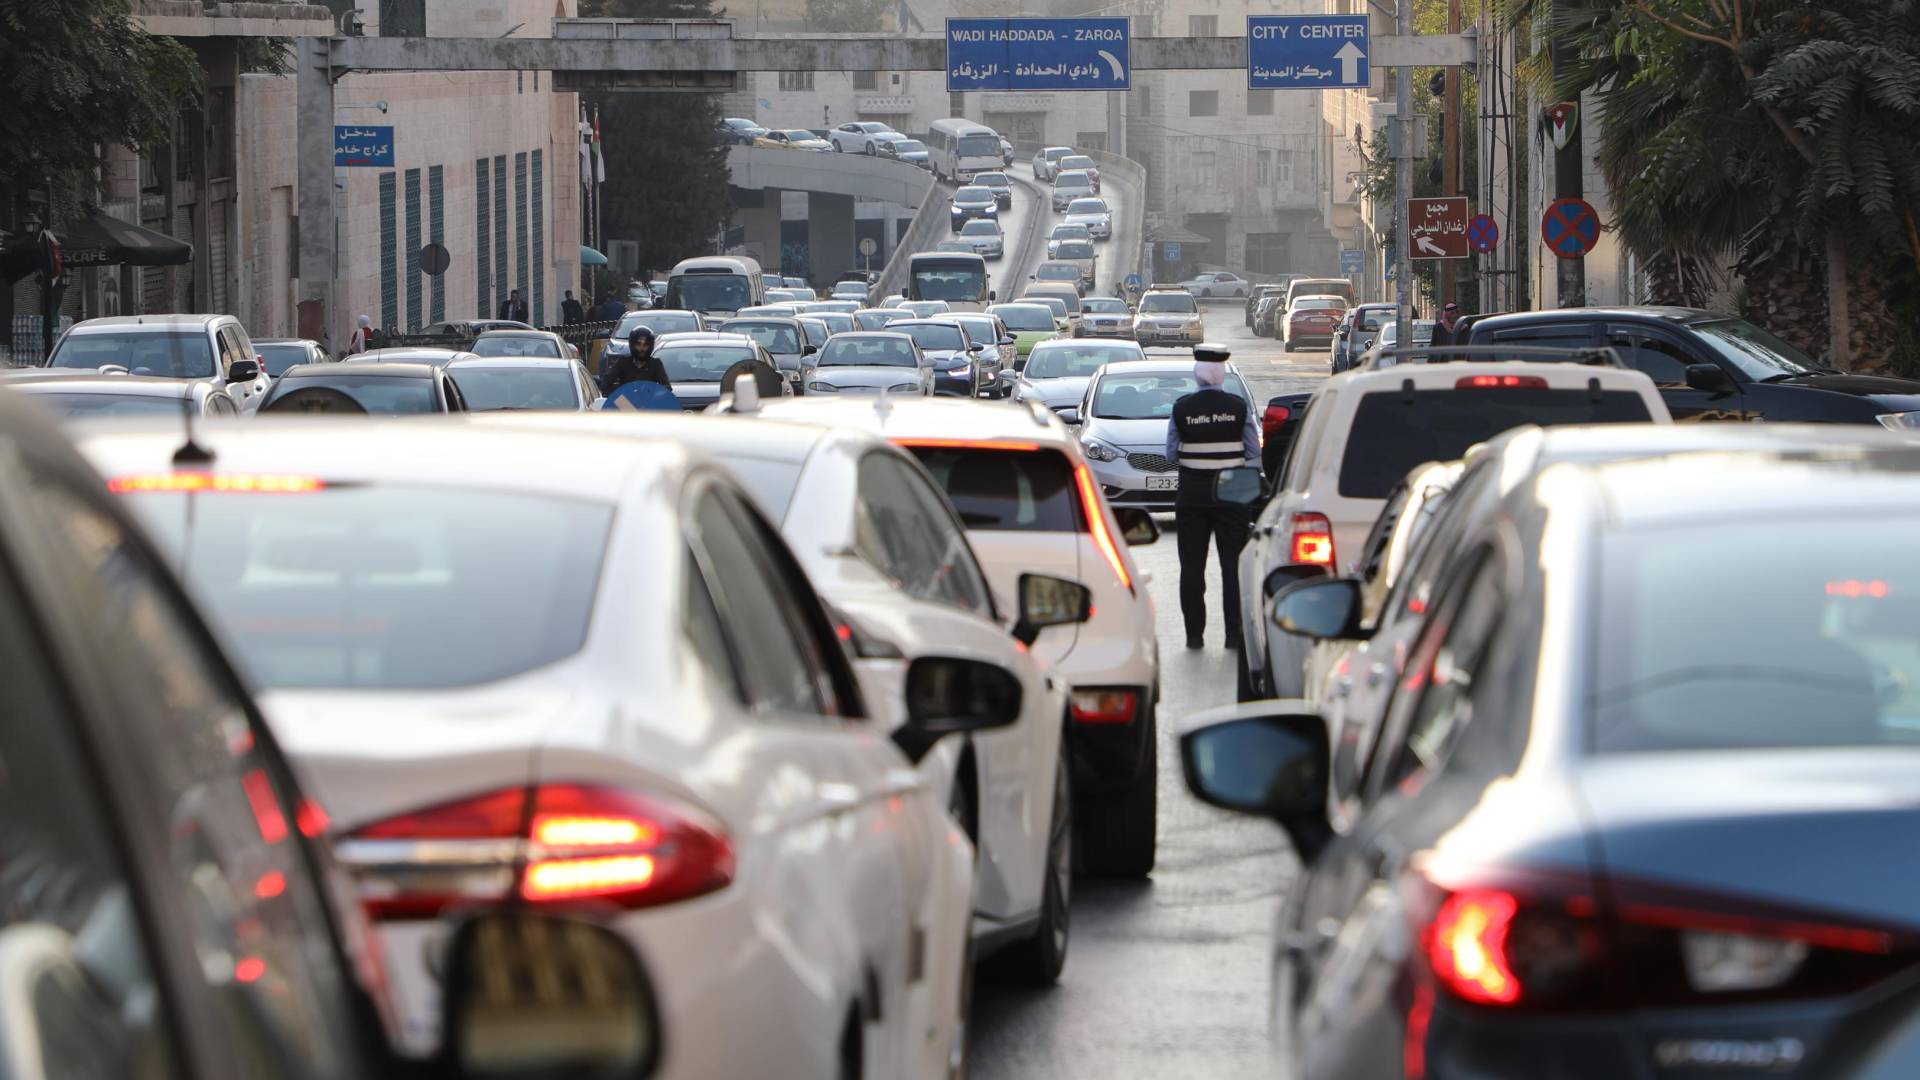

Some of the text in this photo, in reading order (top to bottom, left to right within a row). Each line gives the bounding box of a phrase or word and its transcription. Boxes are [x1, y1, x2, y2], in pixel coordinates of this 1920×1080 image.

[951, 29, 985, 41] WADI
[989, 29, 1055, 41] HADDADA
[1074, 28, 1124, 41] ZARQA
[1252, 24, 1365, 39] CITY CENTER
[951, 61, 998, 80] الزرقاء
[1015, 62, 1067, 77] الحدادة
[1068, 62, 1100, 81] وادي
[1253, 64, 1333, 80] مركز المدينة
[340, 128, 377, 140] مدخل
[363, 144, 388, 156] كراج
[1426, 203, 1449, 218] مجمع
[1410, 218, 1466, 239] رغدان السياحي
[60, 249, 107, 264] SCAFE
[1185, 413, 1236, 425] Traffic Police
